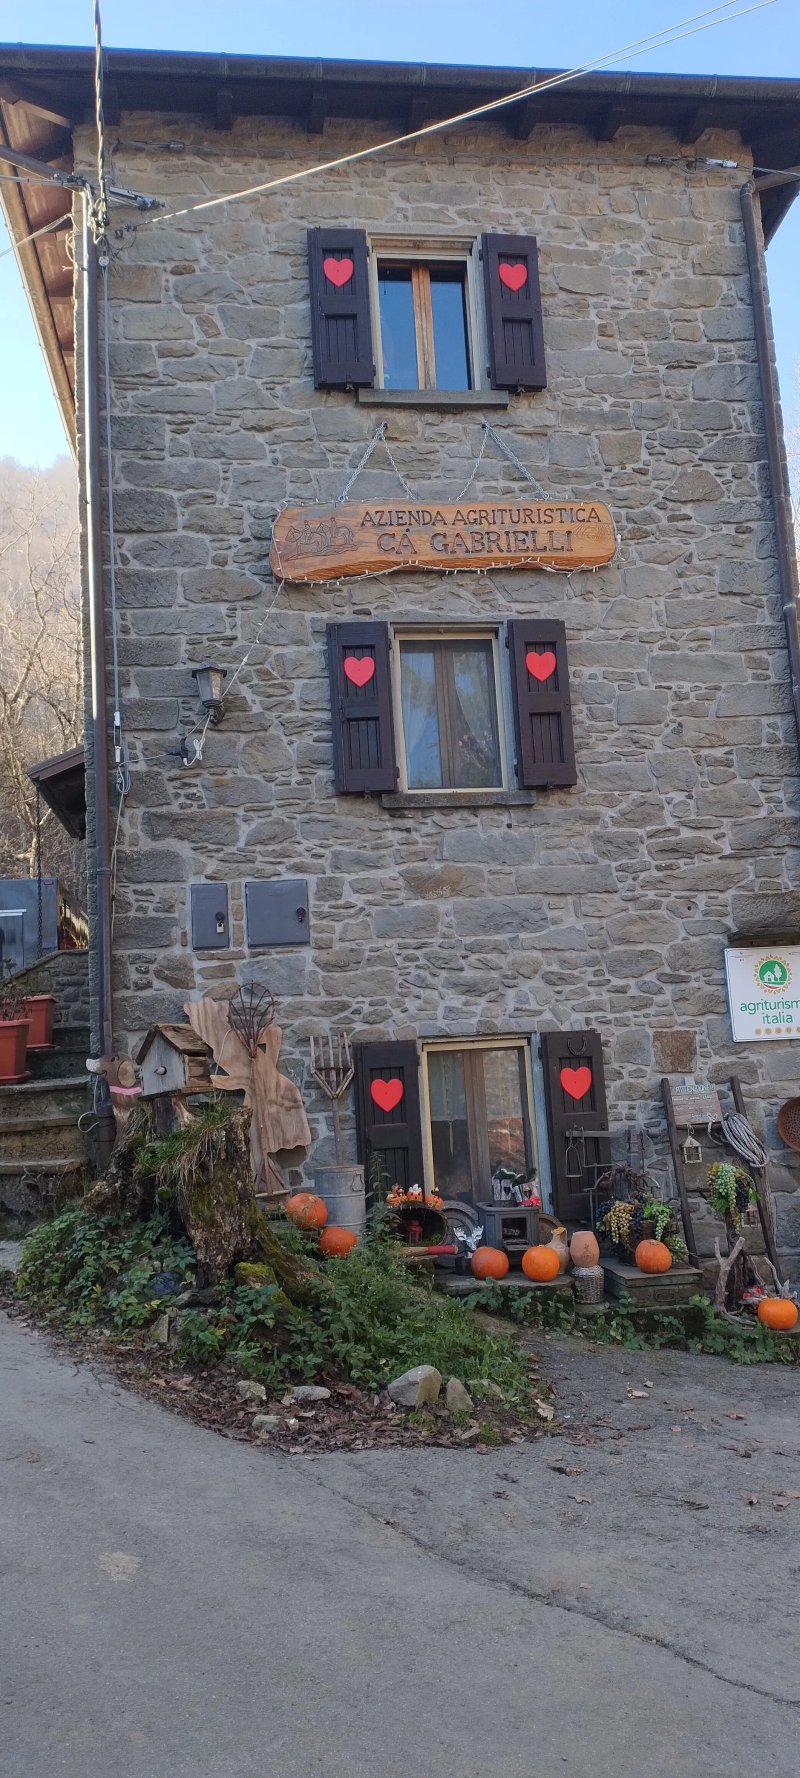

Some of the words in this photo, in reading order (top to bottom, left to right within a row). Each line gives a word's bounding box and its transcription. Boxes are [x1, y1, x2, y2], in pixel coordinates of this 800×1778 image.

[361, 510, 447, 527] AZIENDA
[452, 507, 602, 525] AGRITURISTICA
[430, 531, 574, 553] GABRIELLI
[762, 1011, 793, 1024] italia
